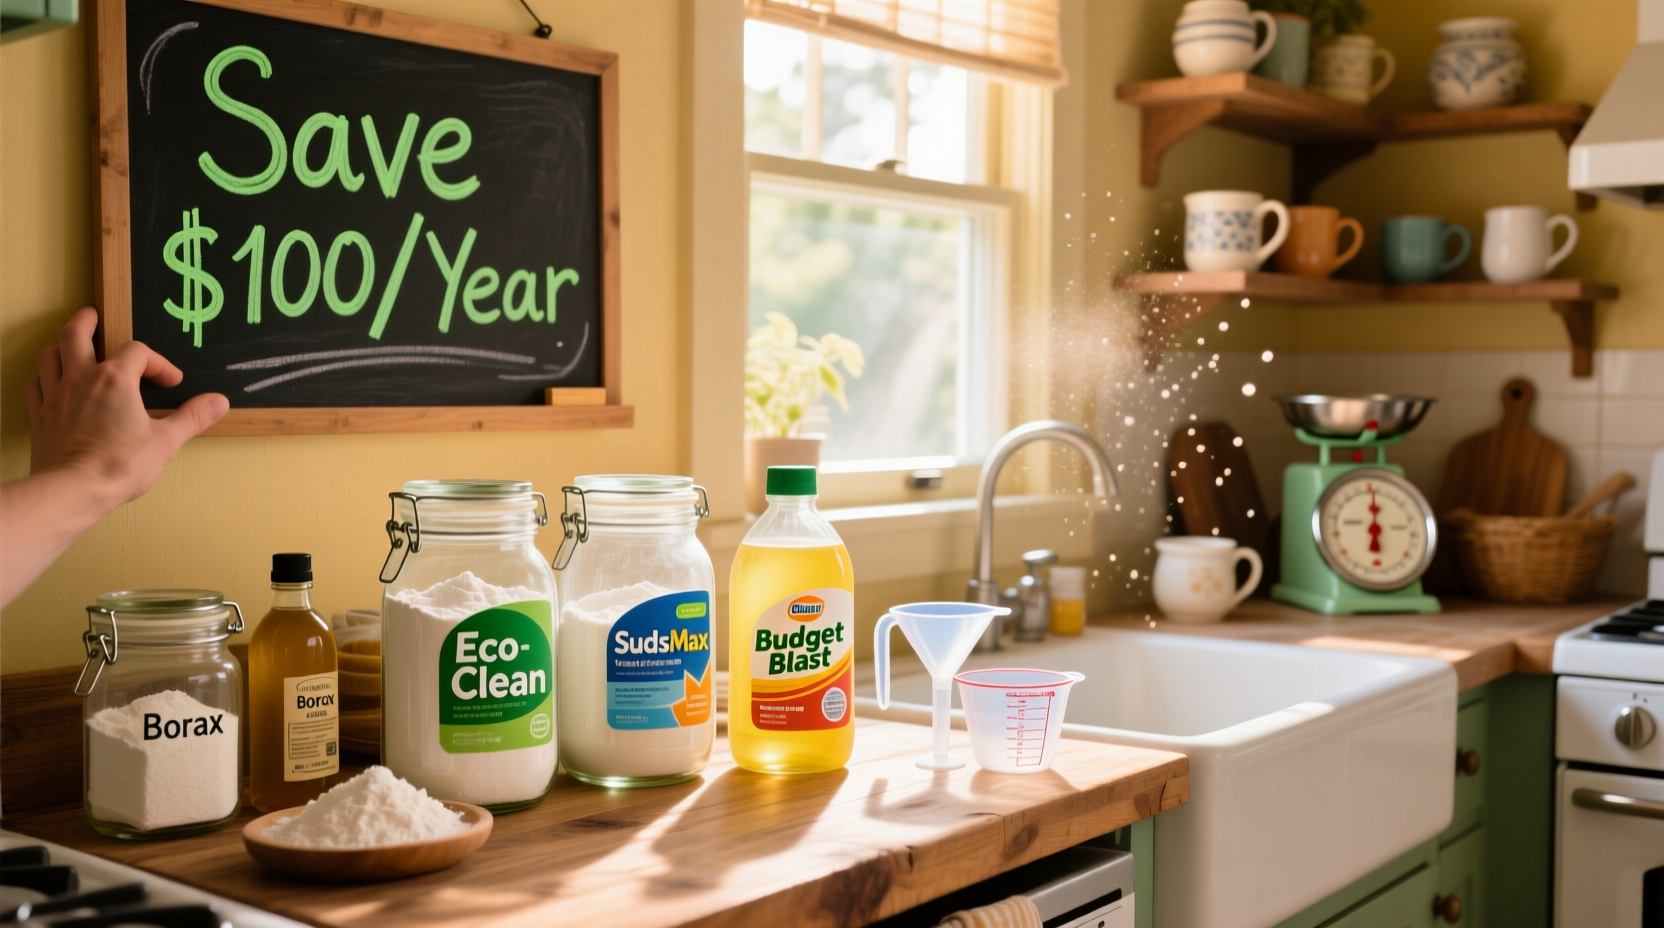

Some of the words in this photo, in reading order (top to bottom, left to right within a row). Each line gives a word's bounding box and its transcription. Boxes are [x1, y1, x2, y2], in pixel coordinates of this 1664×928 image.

[198, 44, 481, 200] Save
[162, 208, 580, 347] $100/Year
[455, 631, 530, 663] Eco-
[614, 628, 709, 654] SudsMax
[755, 621, 844, 652] Budget
[768, 646, 832, 675] Blast
[451, 665, 546, 700] Clean
[297, 693, 335, 709] Borax
[143, 713, 224, 741] Borax
